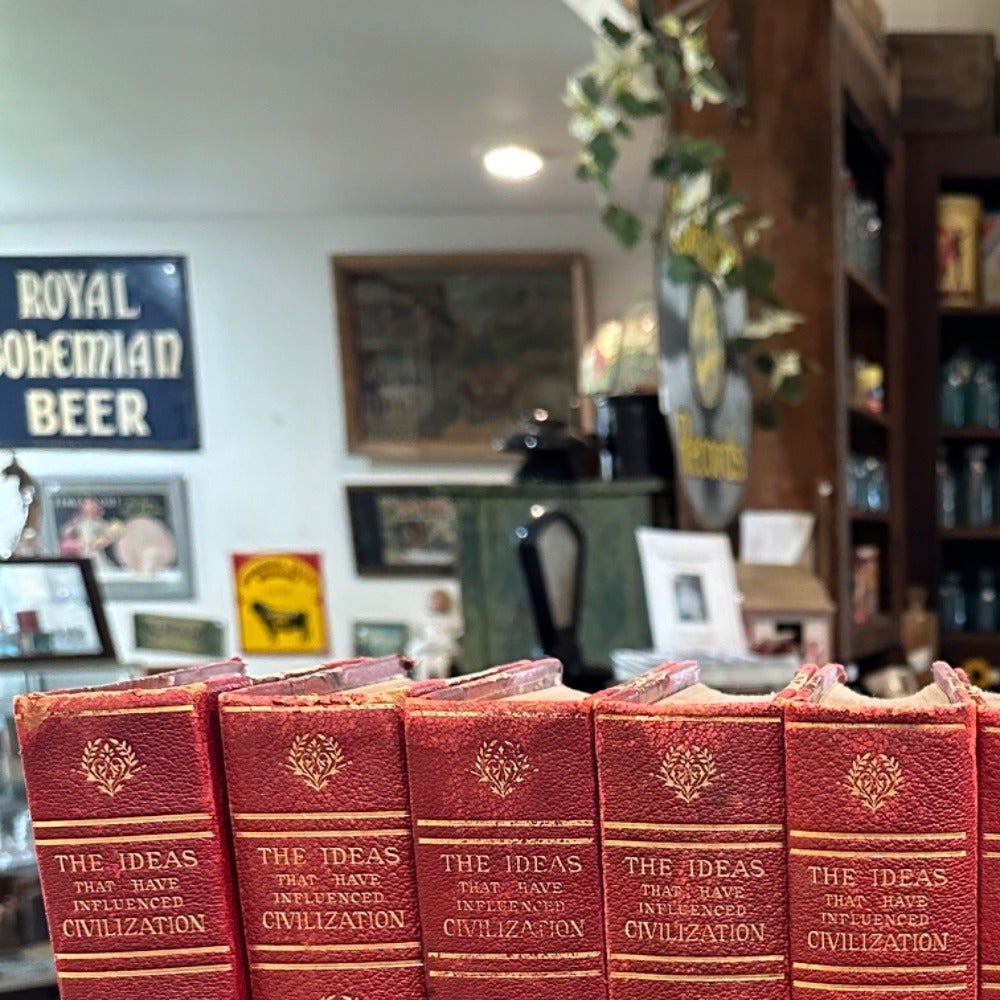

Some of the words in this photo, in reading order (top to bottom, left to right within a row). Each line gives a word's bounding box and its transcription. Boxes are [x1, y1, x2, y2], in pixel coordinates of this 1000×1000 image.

[15, 269, 141, 320] ROYAL
[0, 328, 184, 380] OHEMIAN
[25, 387, 151, 437] BEER
[55, 853, 103, 873] THE
[118, 849, 199, 871] IDEAS
[258, 847, 305, 866] THE
[320, 847, 401, 866] IDEAS
[440, 854, 490, 873] THE
[505, 855, 583, 873] IDEAS
[624, 856, 673, 877] THE
[687, 859, 766, 878] IDEAS
[808, 865, 856, 887] THE
[871, 867, 949, 887] IDEAS
[74, 879, 115, 894] THAT
[132, 877, 180, 892] HAVE
[276, 873, 317, 887] THAT
[334, 873, 381, 887] HAVE
[458, 881, 500, 894] THAT
[517, 881, 563, 894] HAVE
[273, 892, 384, 905] INFLUENCED
[641, 884, 682, 898] THAT
[699, 886, 745, 899] HAVE
[824, 893, 864, 908] THAT
[883, 895, 928, 908] HAVE
[73, 896, 184, 912] INFLUENCED
[456, 900, 565, 912] INFLUENCED
[638, 902, 747, 917] INFLUENCED
[62, 914, 206, 938] CIVILIZATION
[262, 910, 406, 931] CIVILIZATION
[443, 918, 586, 938] CIVILIZATION
[821, 912, 930, 926] INFLUENCED
[625, 920, 766, 942] CIVILIZATION
[807, 930, 949, 952] CIVILIZATION
